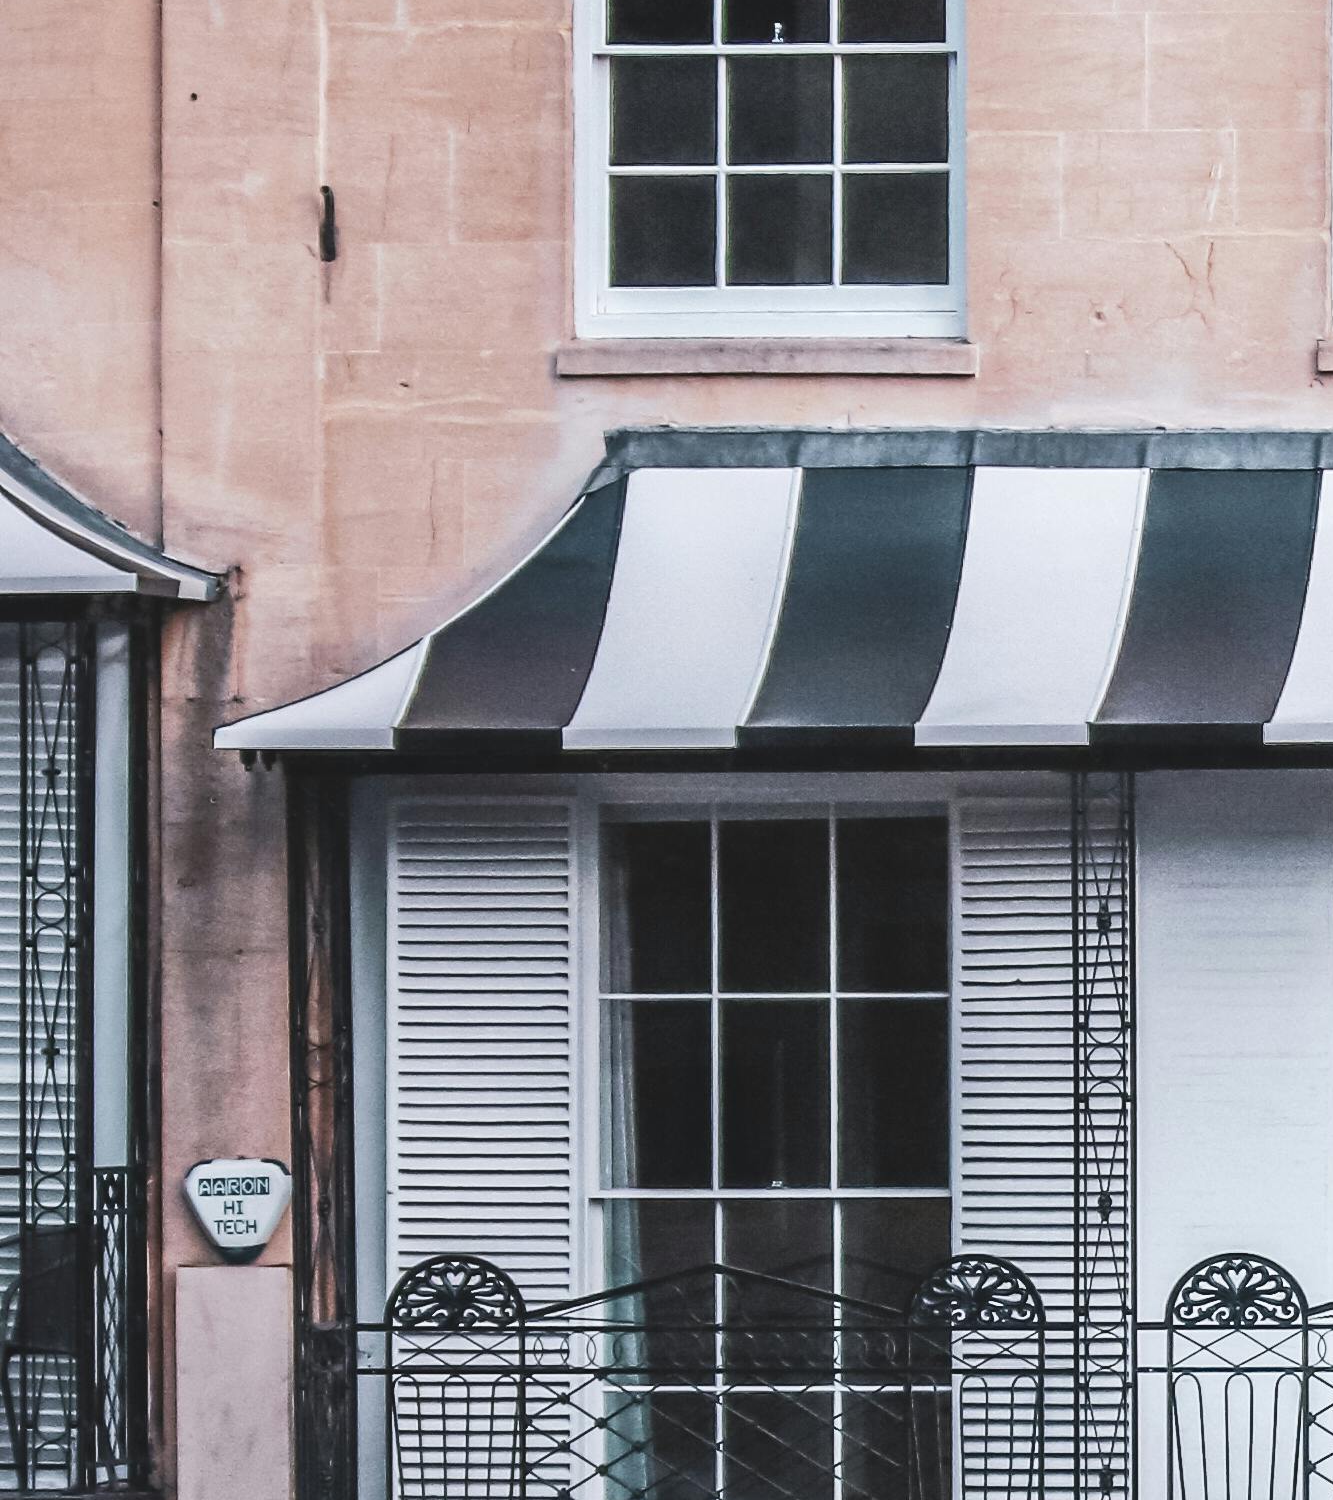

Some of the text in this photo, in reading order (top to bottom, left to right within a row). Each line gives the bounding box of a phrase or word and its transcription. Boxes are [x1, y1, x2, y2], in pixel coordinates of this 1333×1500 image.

[199, 1177, 269, 1196] AARON
[223, 1200, 244, 1215] HI
[214, 1220, 258, 1235] TECH
